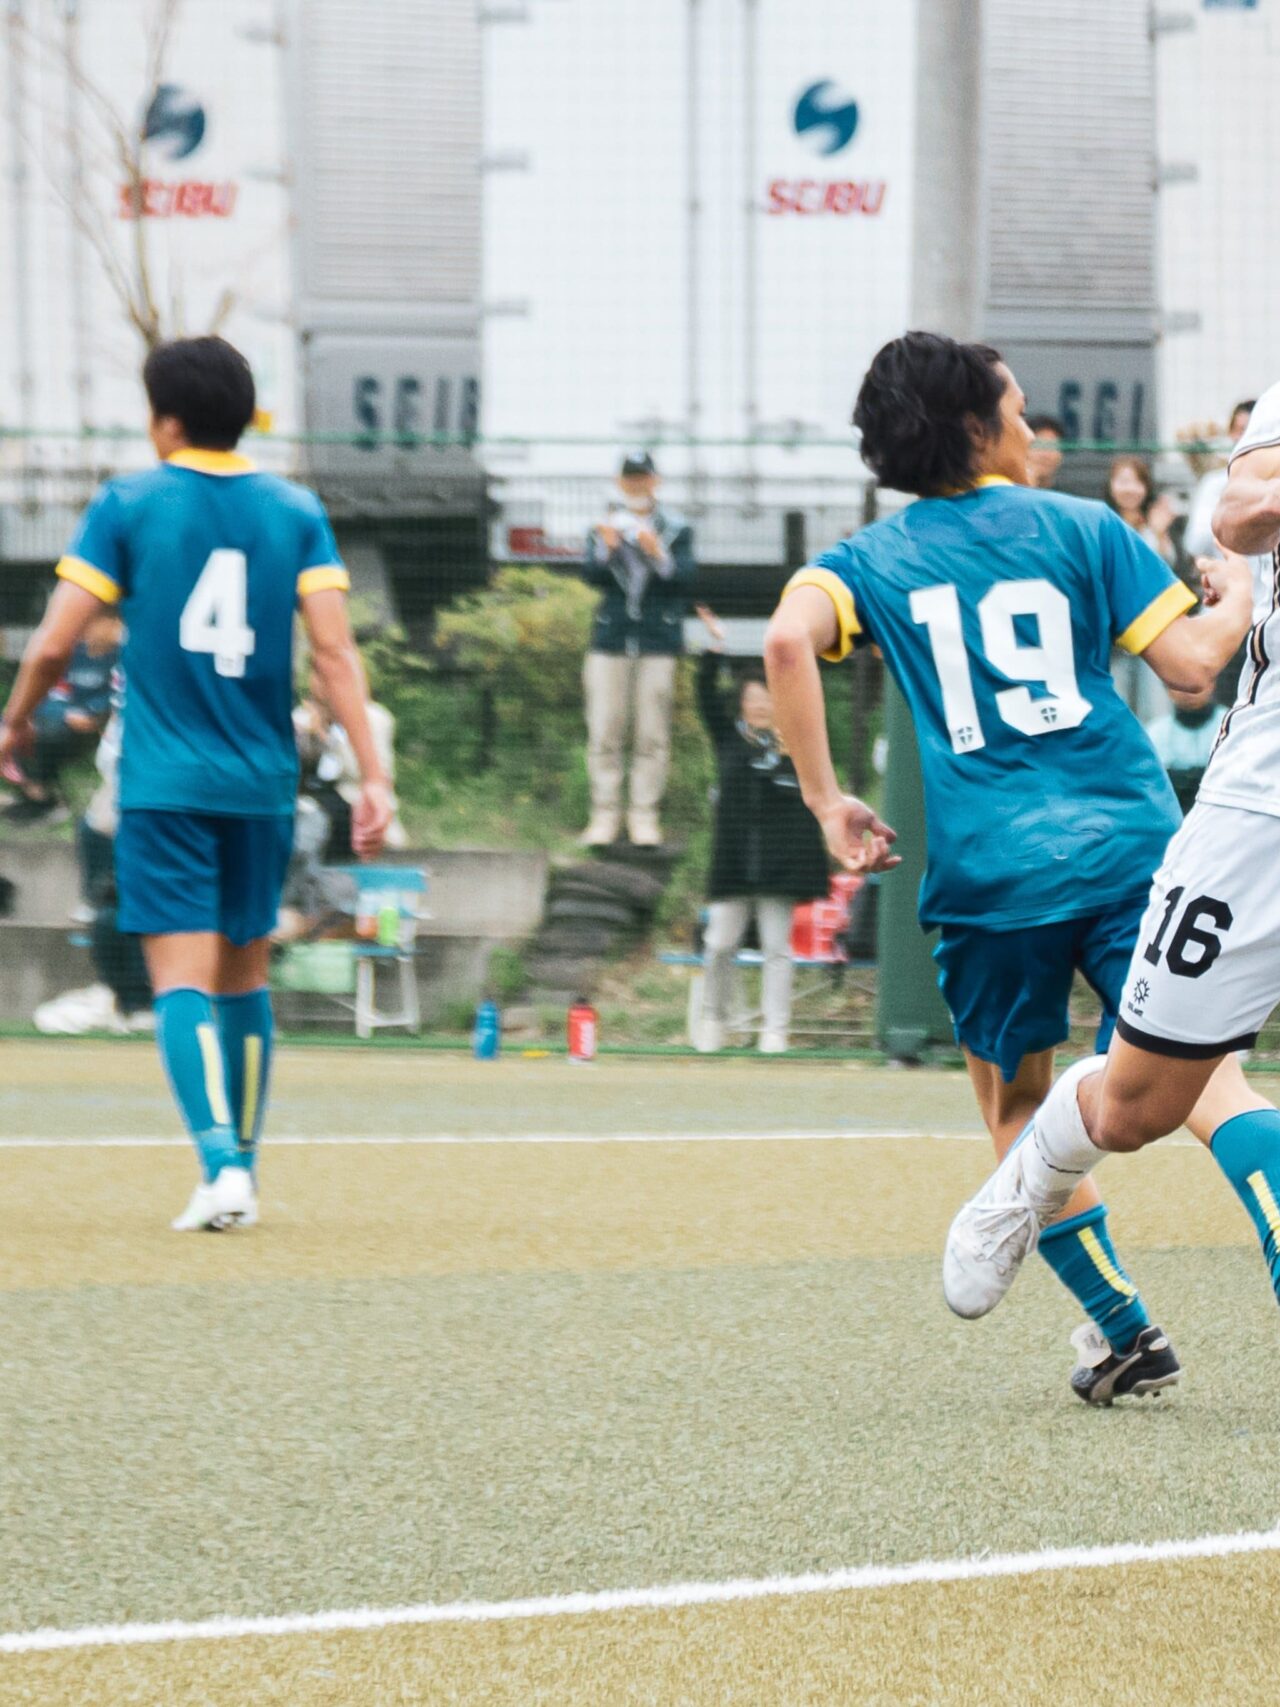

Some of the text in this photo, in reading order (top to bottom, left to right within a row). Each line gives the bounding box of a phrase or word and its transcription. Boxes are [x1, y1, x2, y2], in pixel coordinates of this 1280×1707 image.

[179, 548, 256, 678] 4
[908, 577, 1094, 755] 19
[1143, 885, 1234, 979] 16
